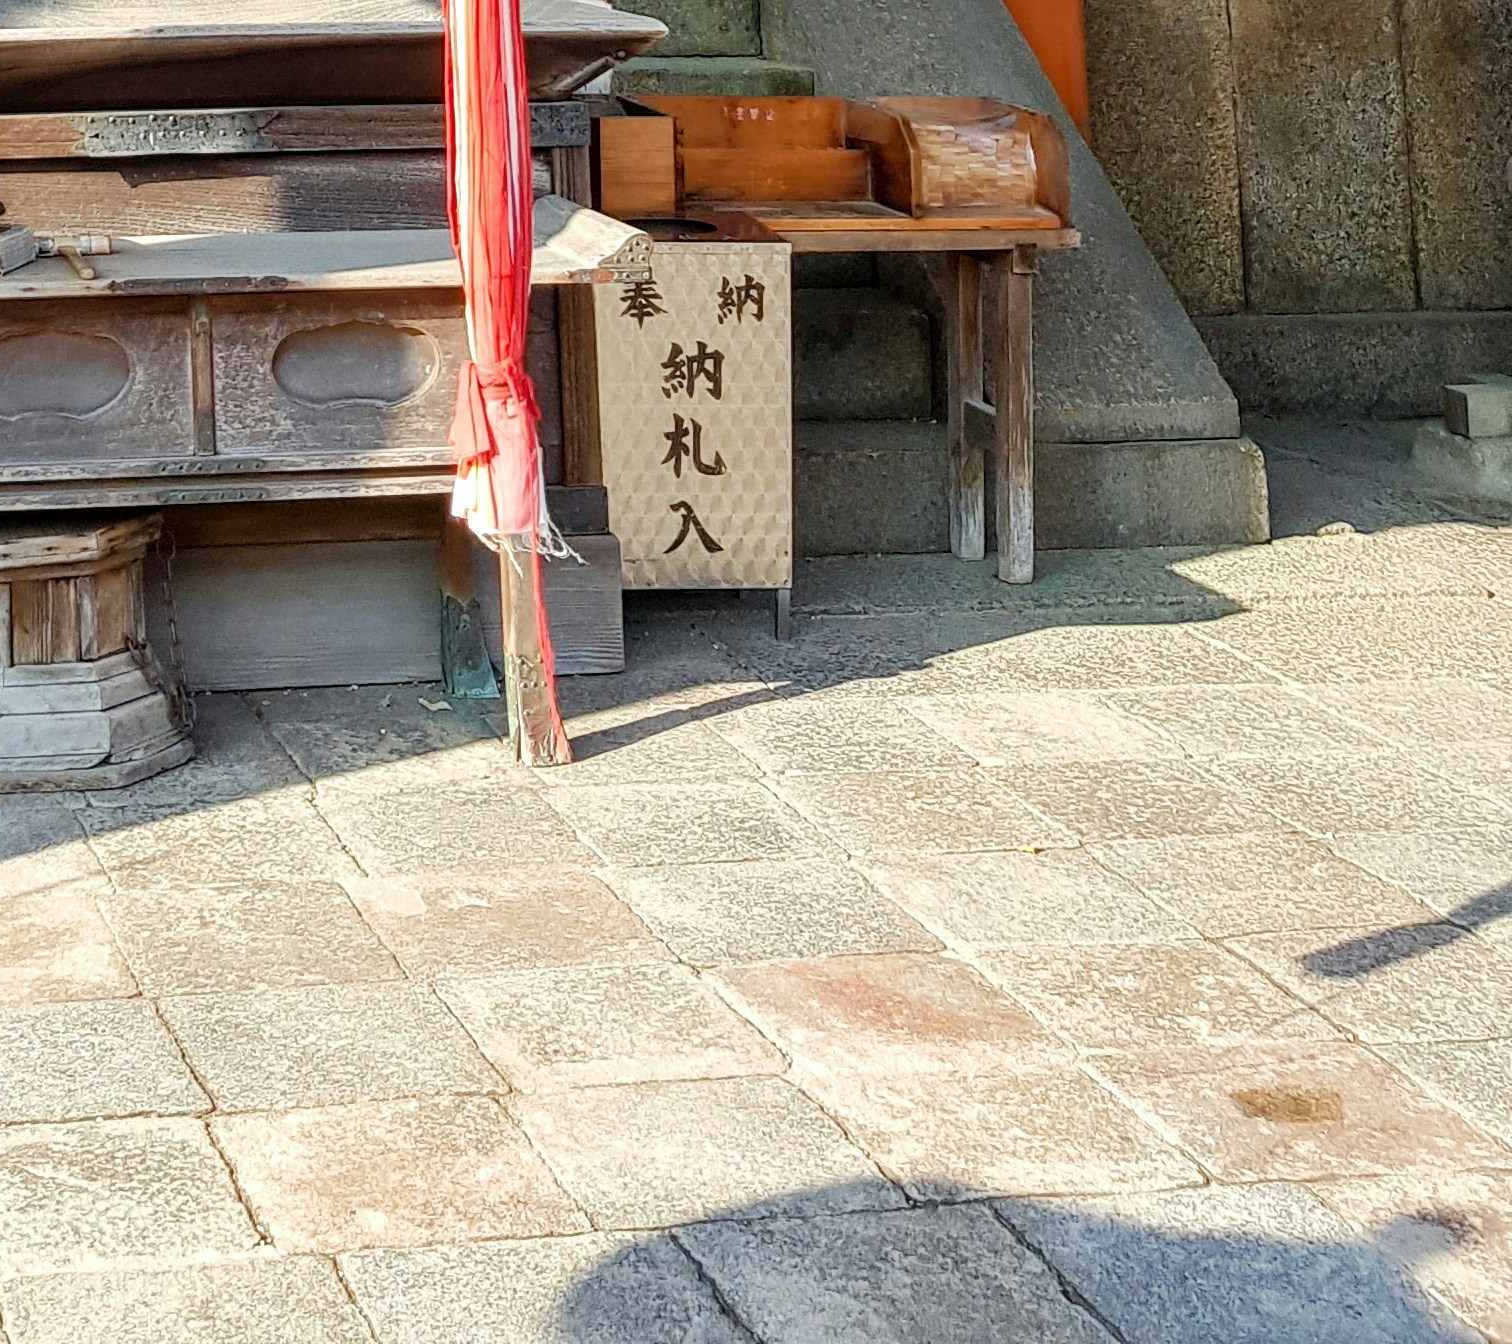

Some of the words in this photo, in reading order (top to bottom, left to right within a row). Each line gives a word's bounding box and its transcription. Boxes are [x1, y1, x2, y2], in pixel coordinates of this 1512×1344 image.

[619, 274, 766, 330] 奉納
[660, 340, 728, 555] 納札入
